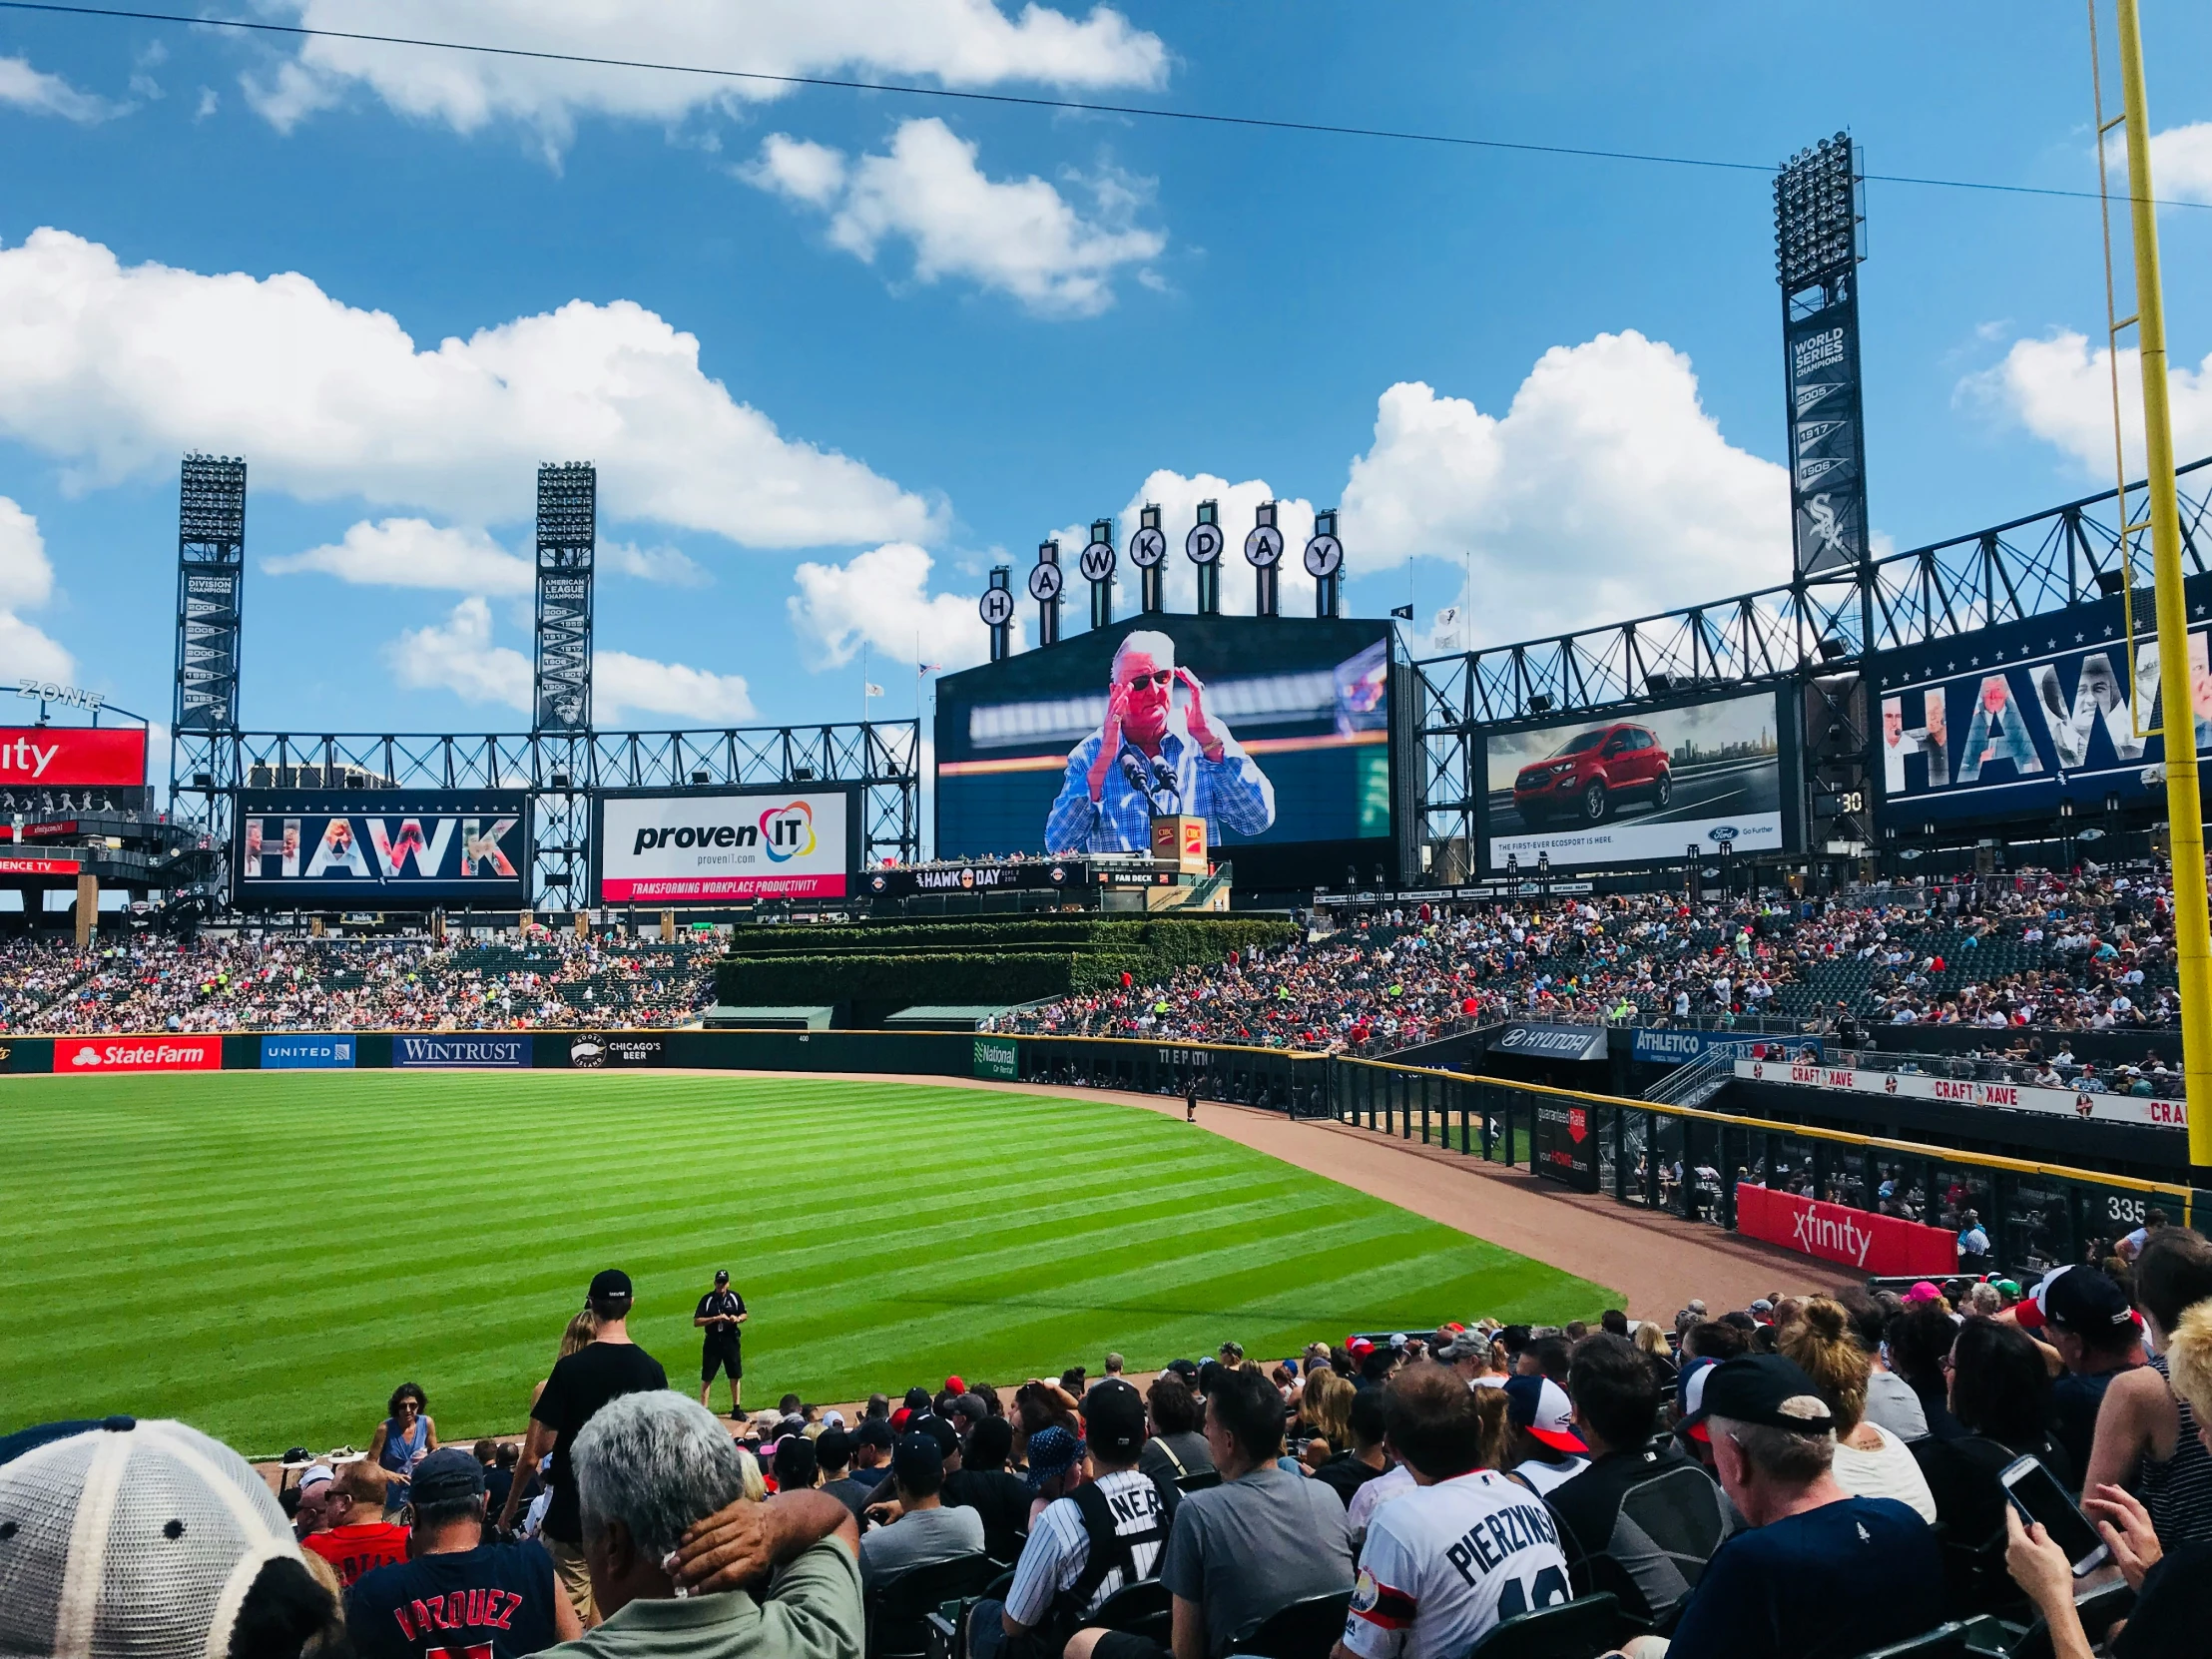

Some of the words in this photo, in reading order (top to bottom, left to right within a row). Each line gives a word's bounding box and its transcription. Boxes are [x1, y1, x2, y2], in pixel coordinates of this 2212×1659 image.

[1795, 326, 1844, 354] WORLD
[1796, 340, 1844, 368] SERIES
[1797, 353, 1844, 377] CHAMPIONS
[1798, 386, 1827, 405] 2005
[1800, 424, 1829, 441] 1917
[1802, 460, 1831, 478] 1906
[545, 585, 584, 594] LEAGUE
[17, 679, 105, 713] ZONE
[633, 825, 759, 855] proven
[775, 819, 802, 845] IT
[1158, 828, 1174, 836] CIBC
[1186, 828, 1201, 838] CIBC
[1713, 828, 1734, 839] Ford
[1752, 826, 1774, 834] Further
[244, 818, 519, 877] HAWK
[1551, 838, 1585, 847] ECOSPORT
[36, 861, 52, 870] TV
[698, 853, 756, 866] provenIT.com
[632, 882, 700, 894] TRANSFORMING
[702, 881, 754, 893] WORKPLACE
[756, 879, 819, 892] PRODUCTIVITY
[924, 870, 961, 888] HAWK
[975, 868, 1001, 885] DAY
[577, 1034, 602, 1044] GOOSE
[609, 1042, 661, 1051] CHICAGO'S
[1522, 1031, 1592, 1051] HYUNDAI
[1636, 1030, 1699, 1054] ATHLETICO
[269, 1047, 331, 1057] UNITED
[623, 1051, 647, 1060] BEER
[983, 1044, 1015, 1064] National
[576, 1057, 602, 1068] ISLAND
[1792, 1066, 1820, 1084] CRAFT
[1935, 1080, 1973, 1100] CRAFT
[1538, 1107, 1570, 1124] guaranteed
[1569, 1110, 1585, 1127] Rate
[1572, 1159, 1588, 1172] team
[2108, 1197, 2146, 1225] 335
[1793, 1204, 1873, 1268] xfinity
